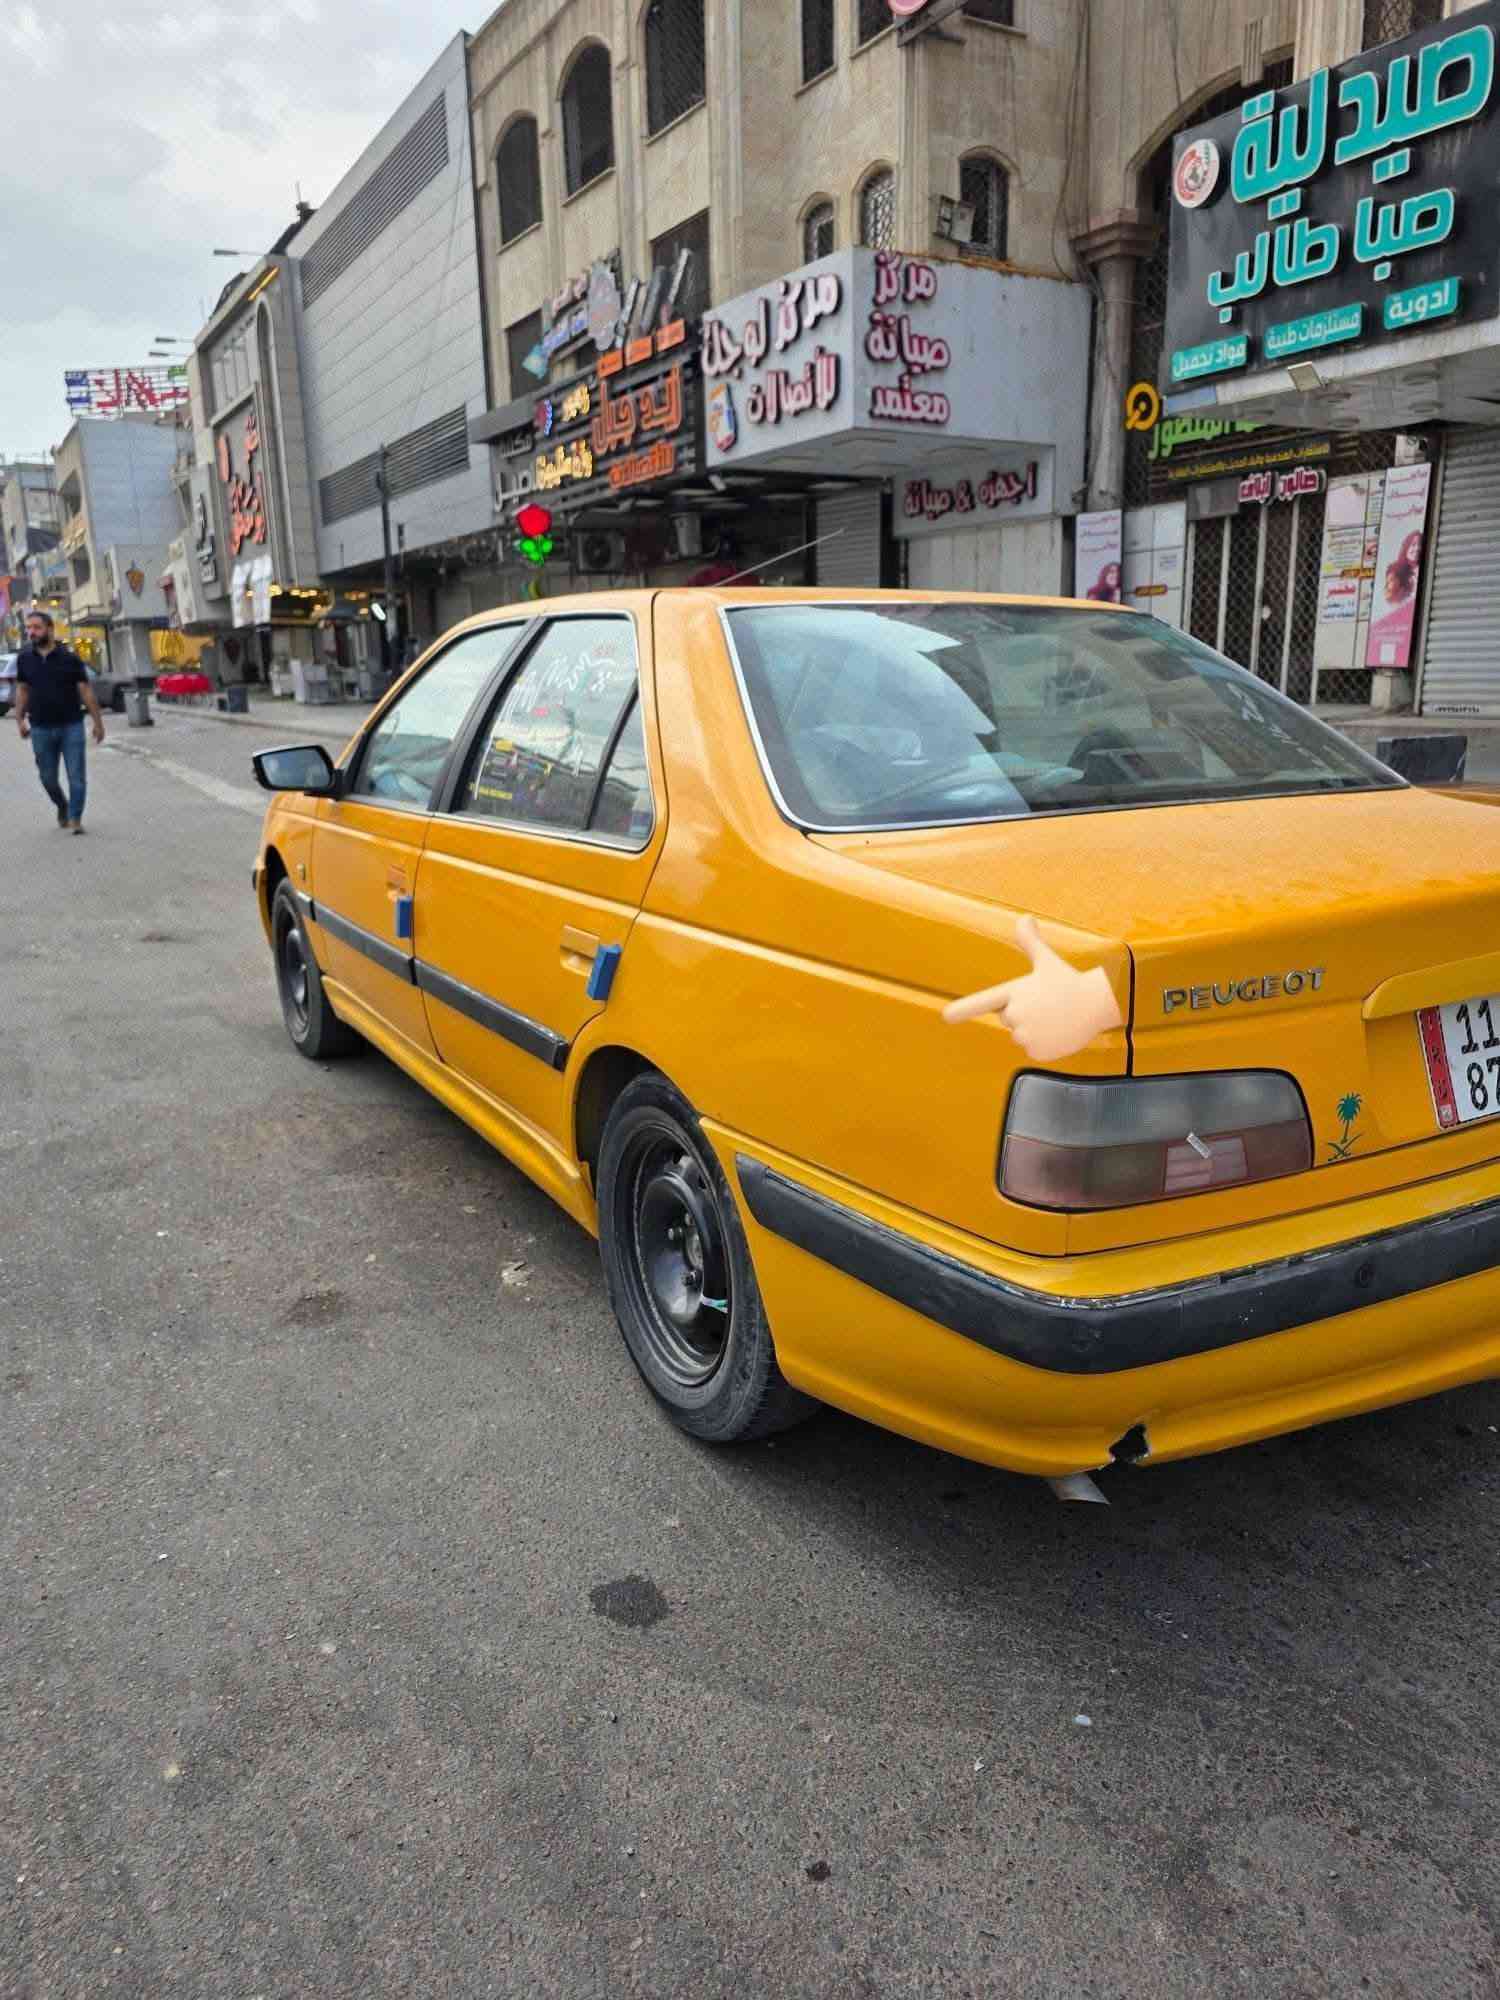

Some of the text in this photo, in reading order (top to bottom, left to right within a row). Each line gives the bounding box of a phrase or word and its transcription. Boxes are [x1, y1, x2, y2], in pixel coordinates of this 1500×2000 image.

[1231, 24, 1494, 221] صيدلية
[873, 252, 937, 306] مركز
[1207, 188, 1455, 324] صبا طالب
[774, 273, 841, 352] مركز
[866, 311, 951, 375] صيانة
[870, 372, 950, 424] معتمد
[904, 479, 952, 521] صيانة
[1163, 967, 1327, 1014] PEUGEOT
